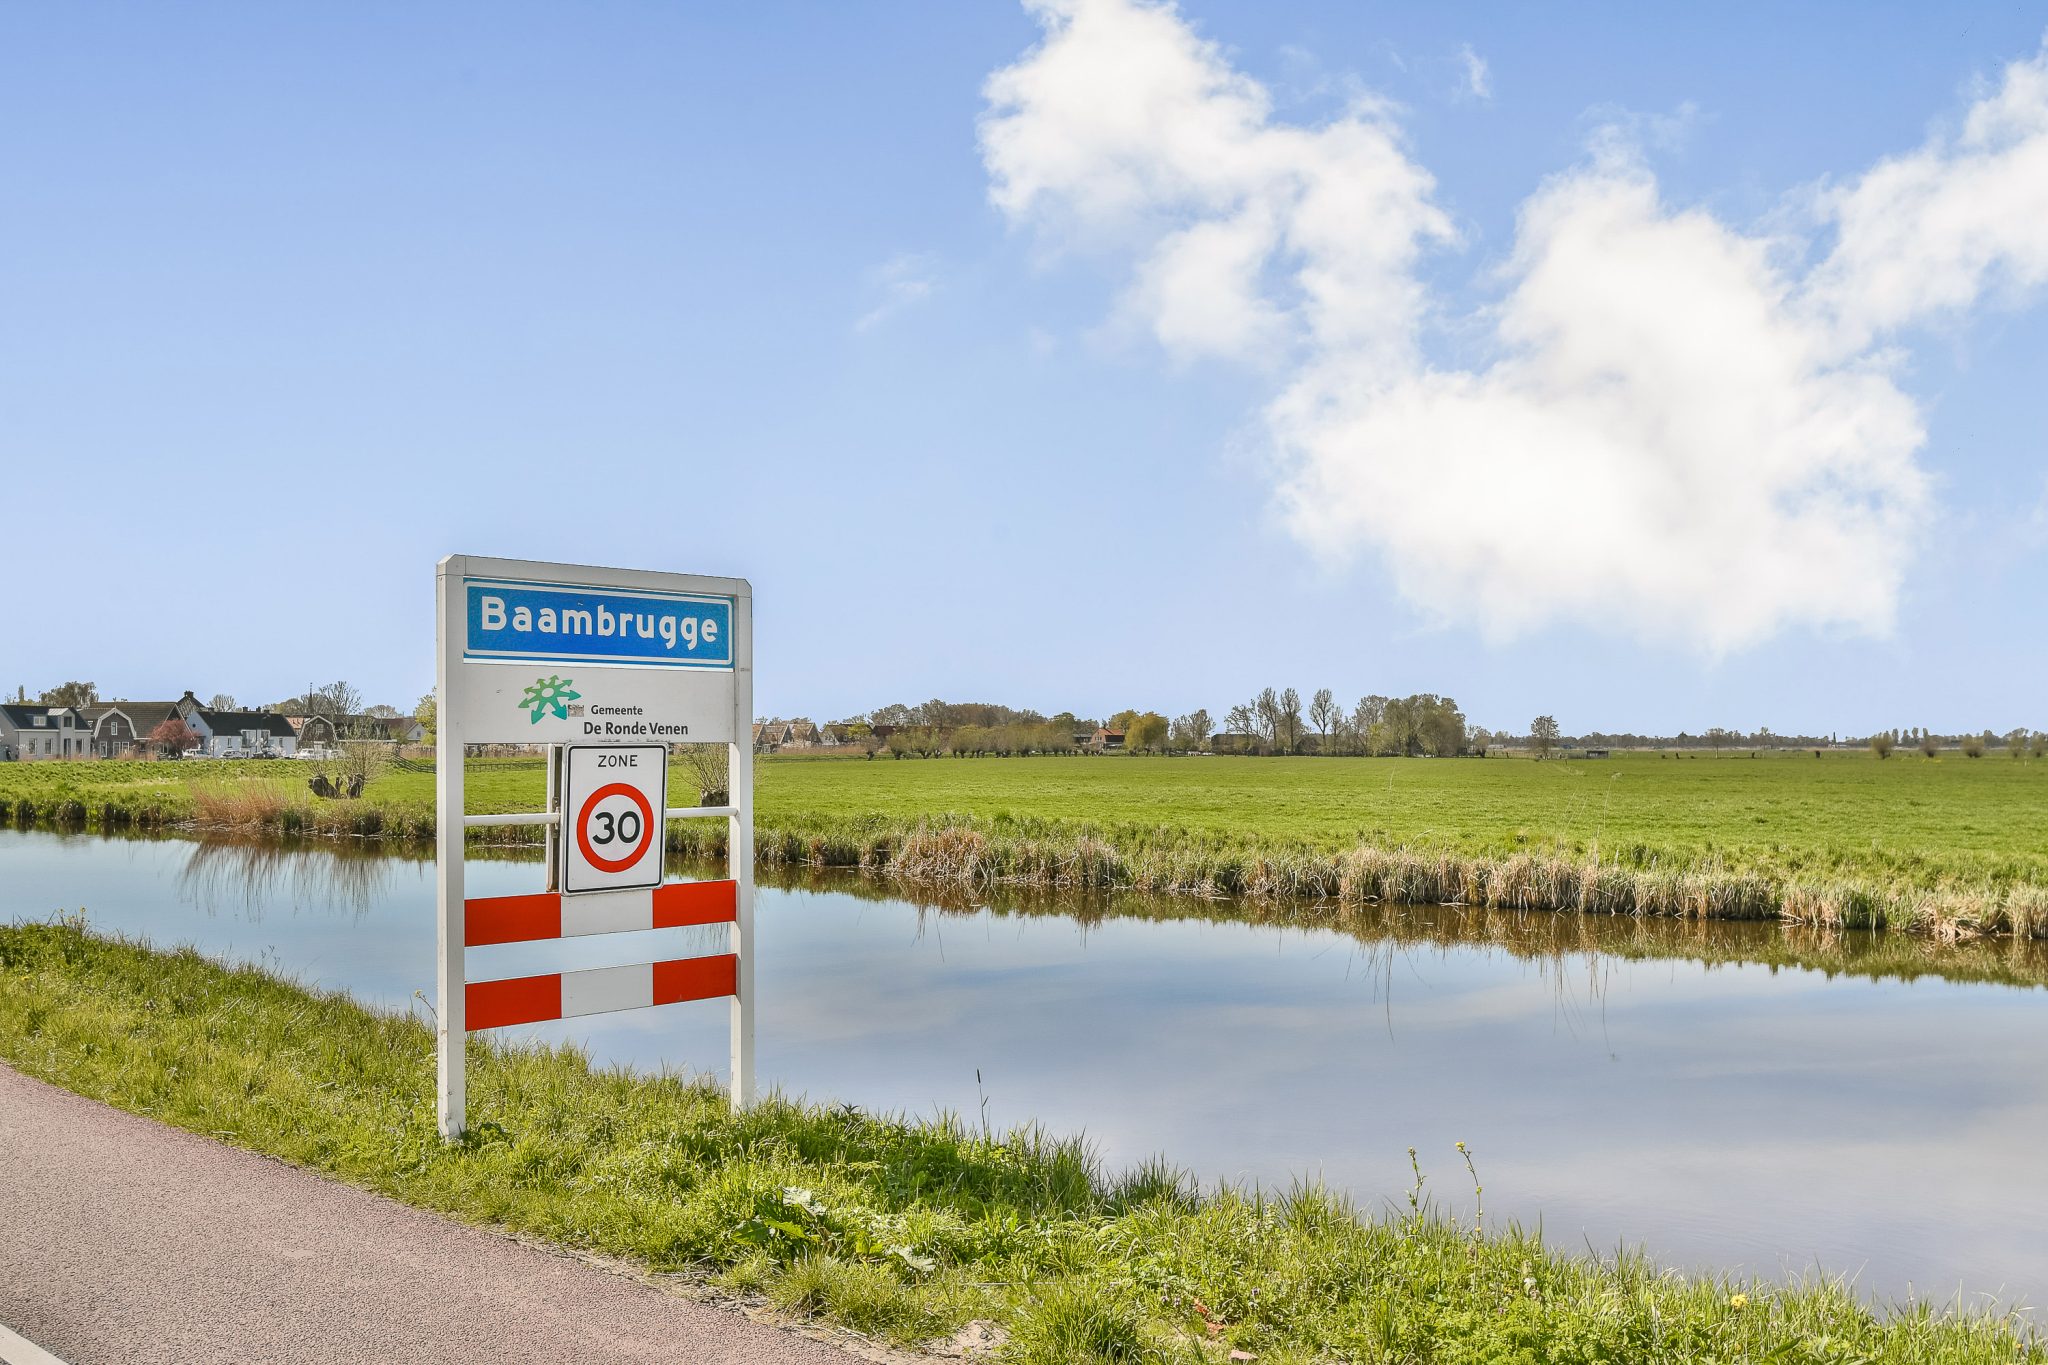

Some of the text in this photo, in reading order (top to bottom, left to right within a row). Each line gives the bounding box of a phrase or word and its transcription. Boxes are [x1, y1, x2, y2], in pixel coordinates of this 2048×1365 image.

[481, 596, 718, 650] Baambrugge
[591, 705, 643, 715] Gemeente
[583, 722, 688, 735] De Ronde Venen
[598, 755, 638, 767] ZONE
[592, 811, 641, 844] 30
